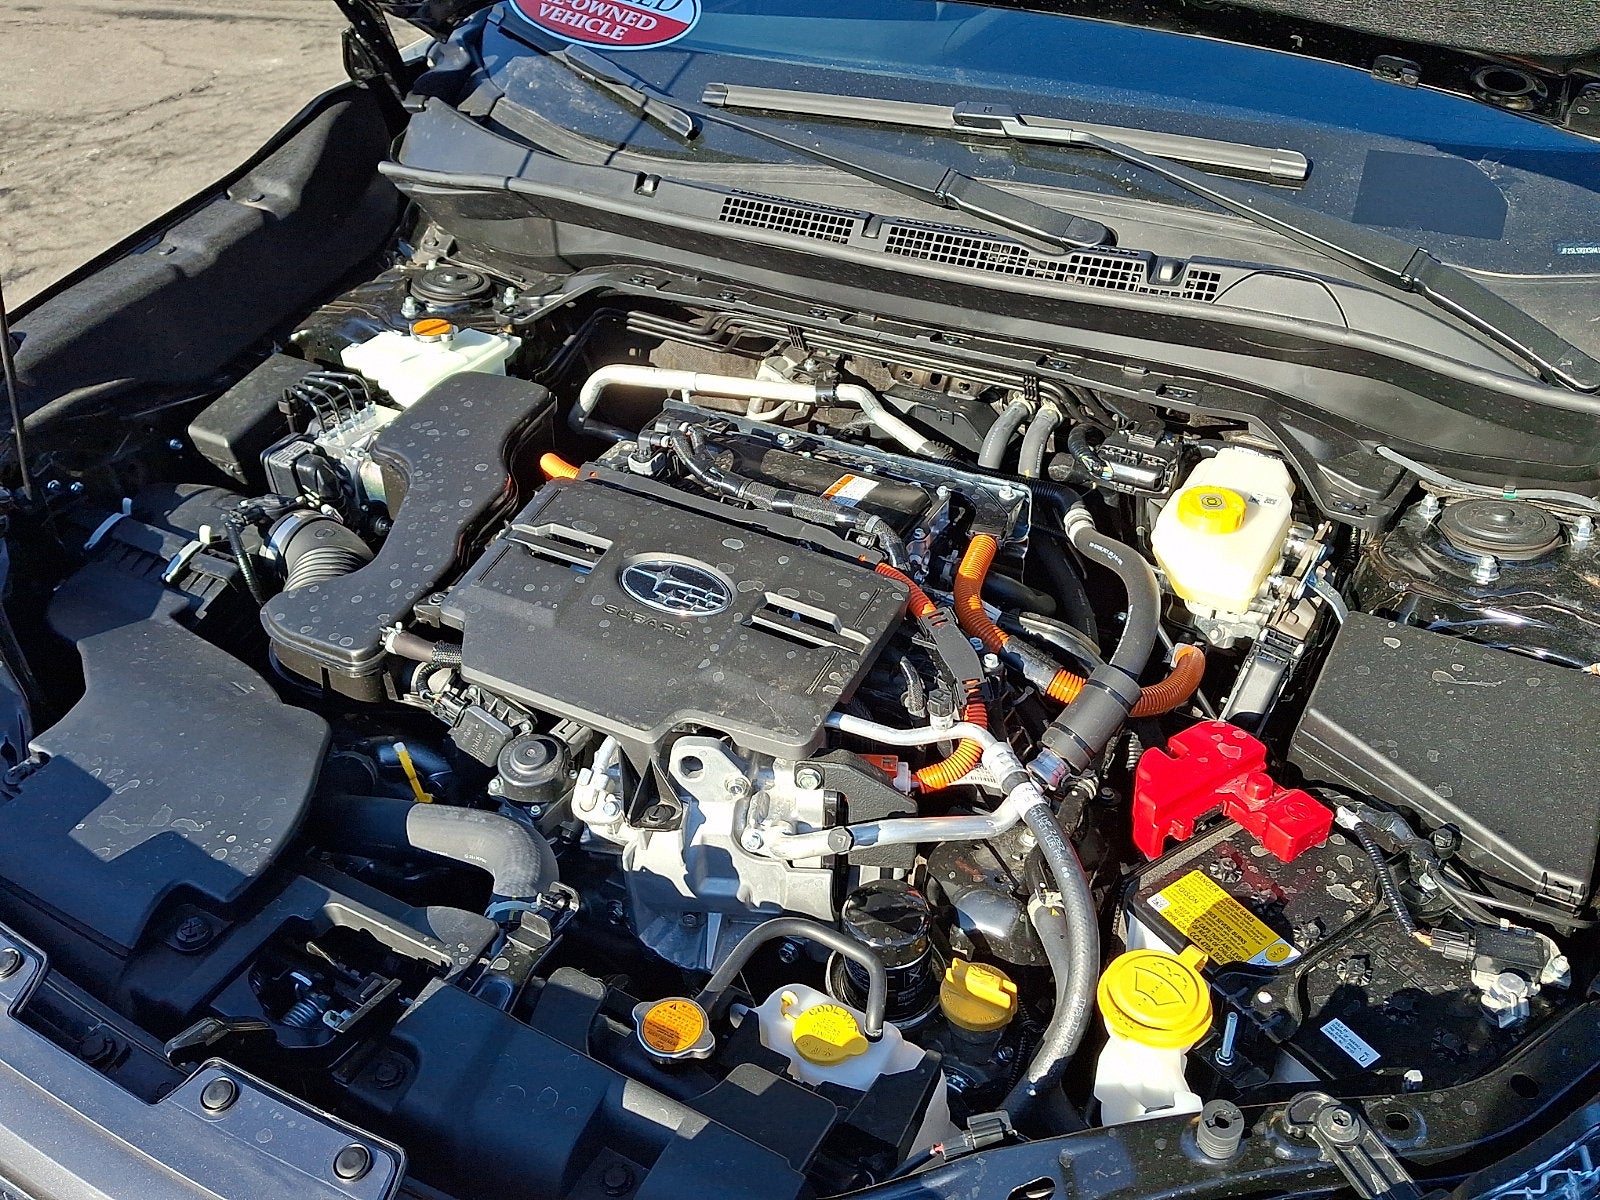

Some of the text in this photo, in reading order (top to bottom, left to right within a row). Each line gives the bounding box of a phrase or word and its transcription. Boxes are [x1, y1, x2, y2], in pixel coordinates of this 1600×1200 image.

[540, 2, 629, 41] VEHICLE
[602, 603, 691, 639] SUBARU
[1173, 883, 1200, 904] POISON
[1215, 918, 1233, 932] SEVERE
[1230, 931, 1247, 944] BURNS
[1192, 871, 1219, 892] DANGER
[1239, 910, 1255, 922] GASES
[1188, 931, 1202, 942] CCA
